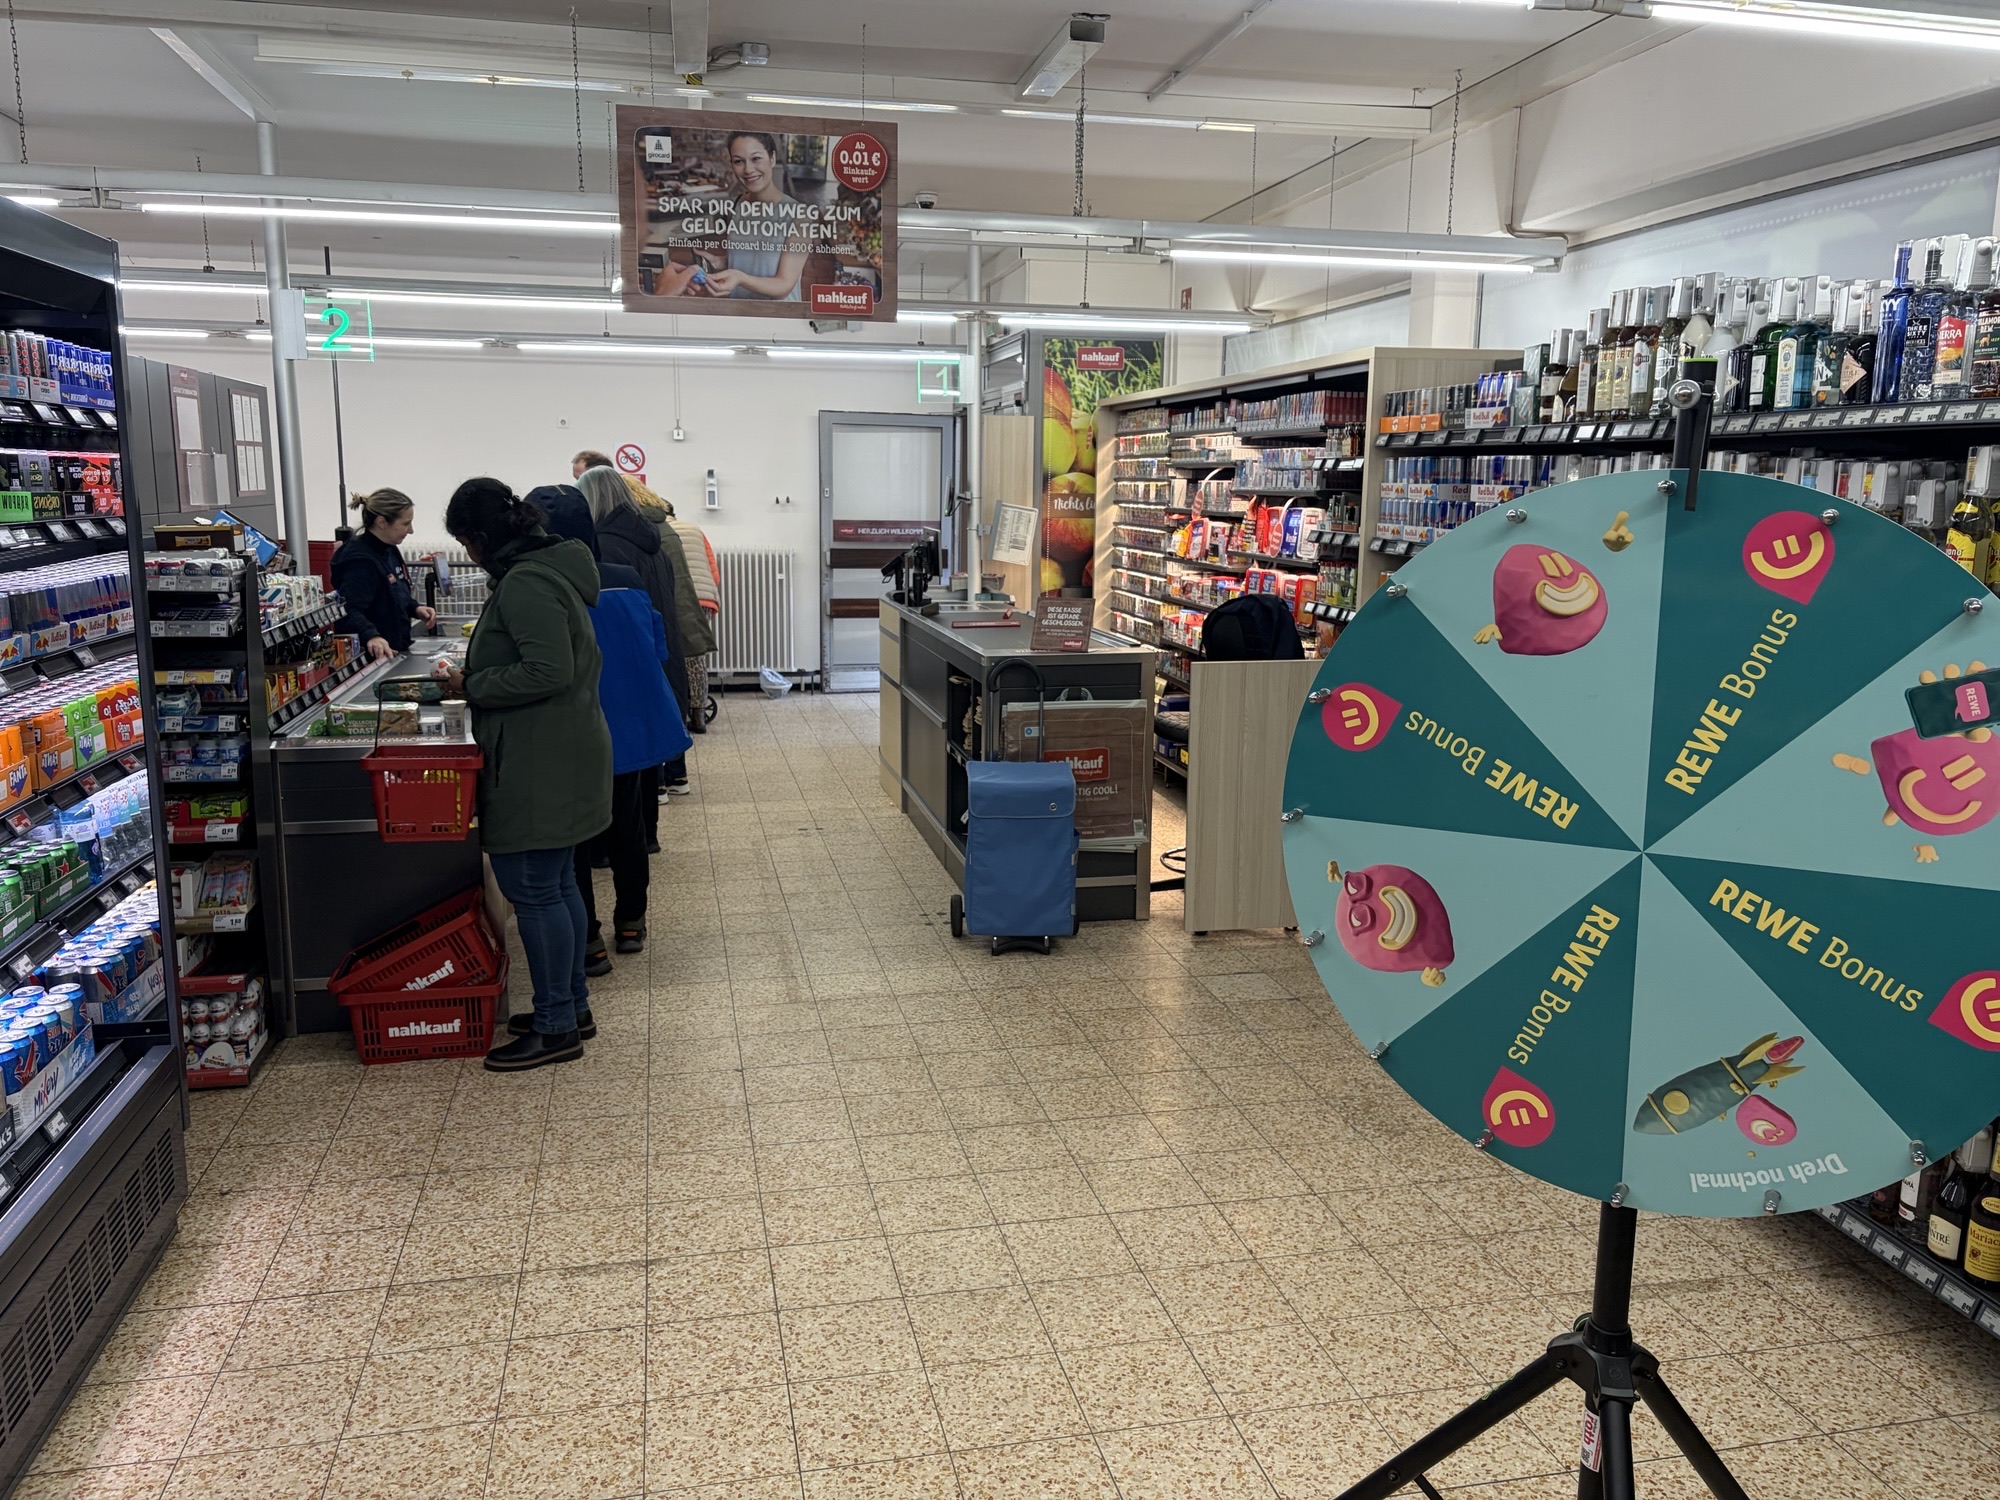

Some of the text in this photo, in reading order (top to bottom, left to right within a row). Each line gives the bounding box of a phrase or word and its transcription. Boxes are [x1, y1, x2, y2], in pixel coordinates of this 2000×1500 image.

[855, 141, 866, 150] Ab
[843, 167, 877, 176] Einkaufs-
[658, 197, 861, 222] SPAR DIR DEN WEG ZUM
[681, 217, 838, 240] GELDAUTOMATEN!
[668, 237, 702, 248] Einfach
[704, 240, 720, 250] per
[721, 240, 760, 251] Girocard
[761, 241, 775, 251] bis
[777, 243, 788, 252] zu
[815, 244, 853, 254] abheben.
[817, 291, 868, 304] nahkauf
[320, 307, 352, 351] 2
[1081, 352, 1121, 362] nahkauf
[936, 366, 948, 397] 1
[1452, 485, 1469, 494] Red
[1054, 496, 1085, 511] Nichts
[1041, 619, 1084, 627] GESCHLOSSEN.
[1664, 608, 1798, 795] REWE Bonus
[1965, 687, 1981, 717] REWE
[333, 714, 344, 724] ja!
[348, 727, 376, 735] TOAST
[9, 763, 28, 787] FANTA
[1404, 710, 1580, 830] REWE Bonus
[1092, 783, 1118, 796] COOL!
[1708, 878, 1924, 1012] REWE Bonus
[1507, 904, 1621, 1065] REWE Bonus
[388, 1018, 462, 1037] nahkauf
[1689, 1153, 1849, 1193] Dreh nochmal
